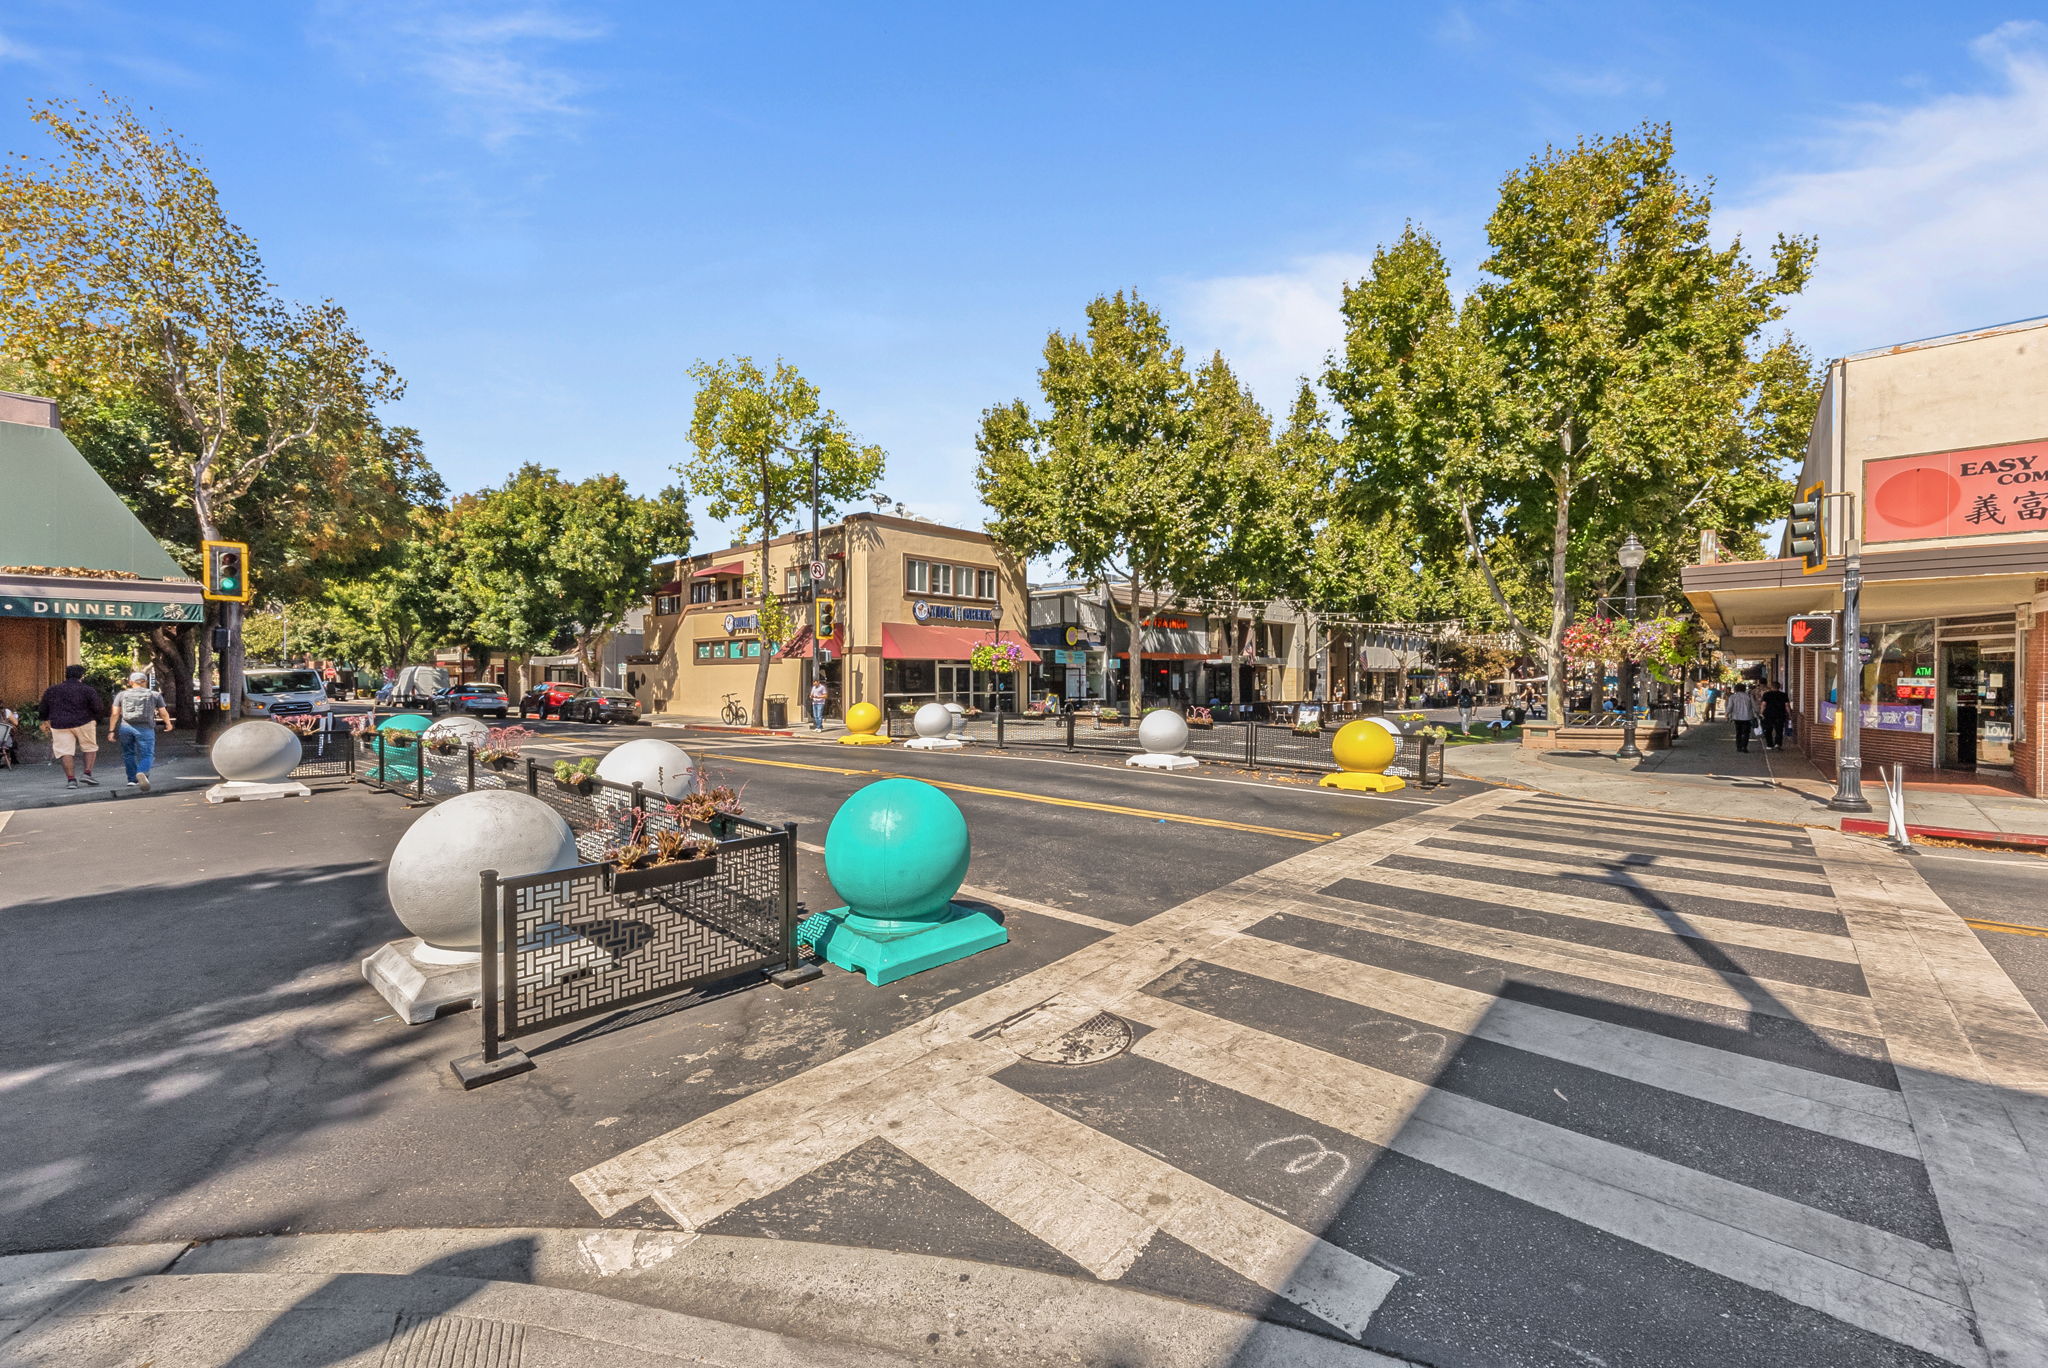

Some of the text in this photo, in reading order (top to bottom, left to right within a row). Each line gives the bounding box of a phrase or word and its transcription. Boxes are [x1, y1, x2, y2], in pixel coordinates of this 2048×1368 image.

[1960, 455, 2039, 477] EASY
[33, 601, 134, 616] DINNER
[1915, 667, 1932, 676] ATM
[1986, 726, 2010, 737] LOW
